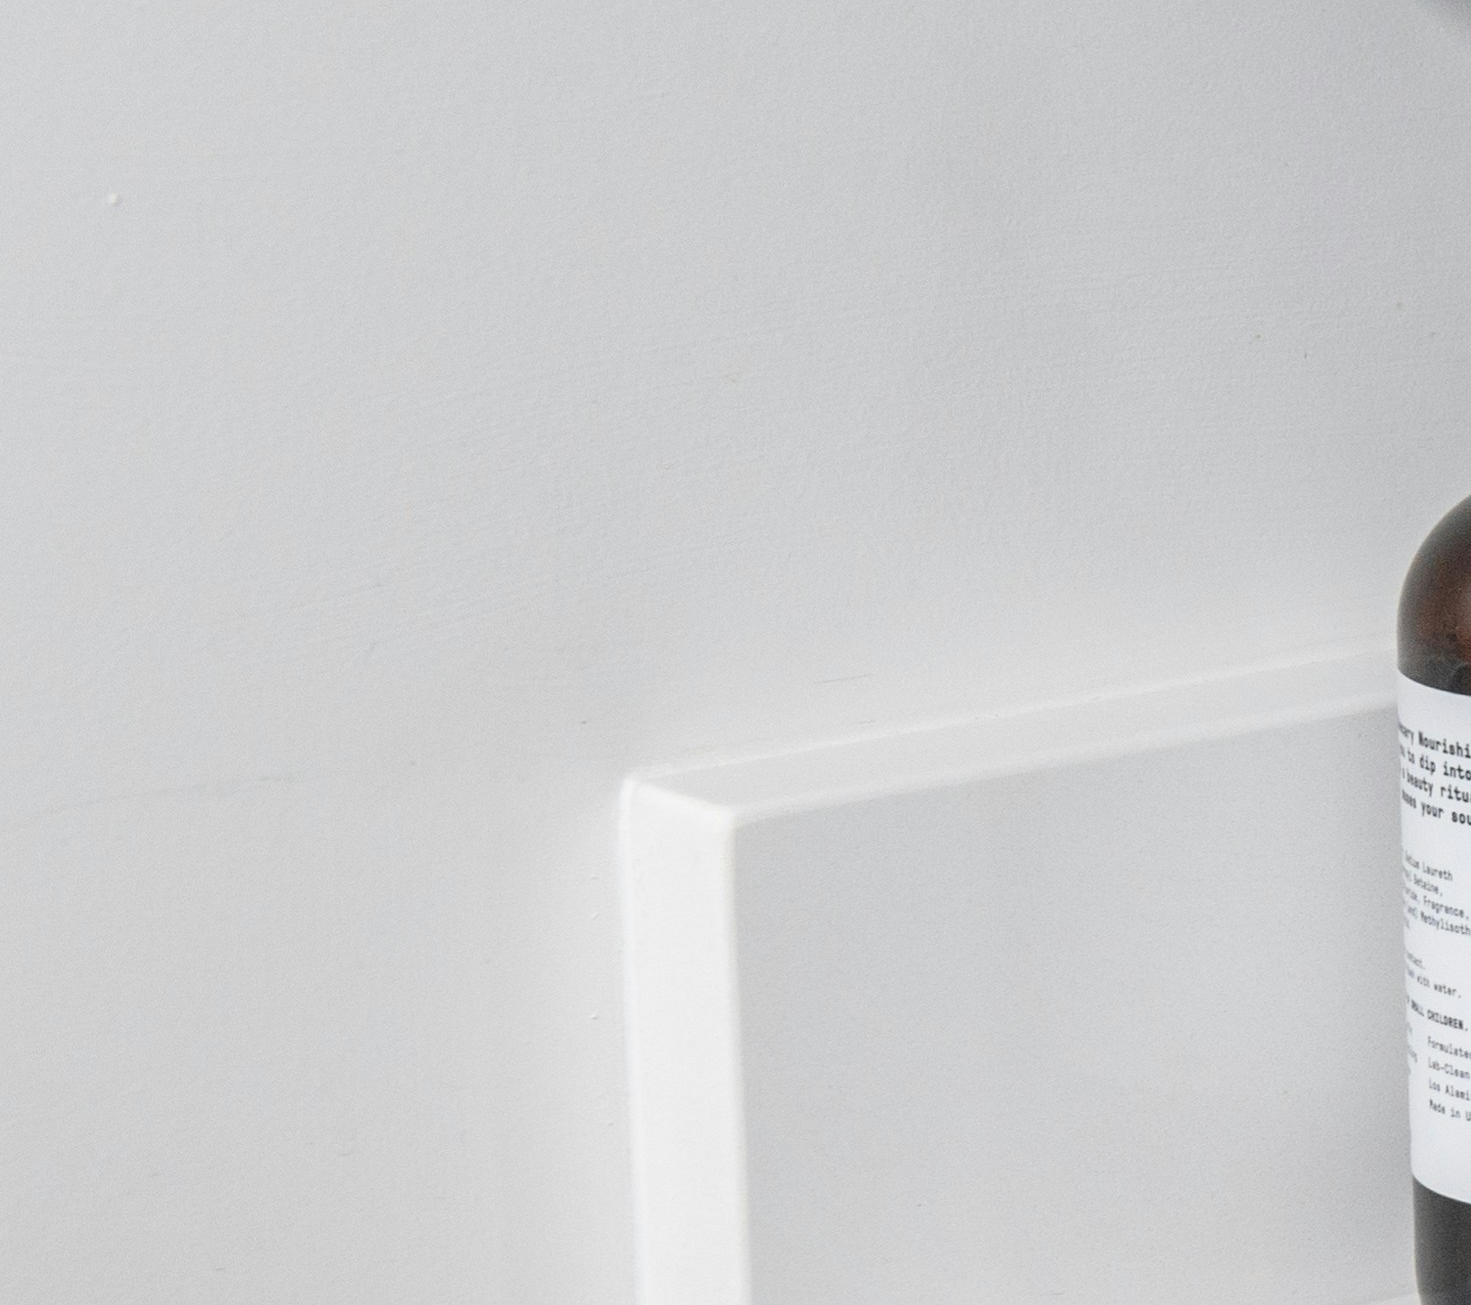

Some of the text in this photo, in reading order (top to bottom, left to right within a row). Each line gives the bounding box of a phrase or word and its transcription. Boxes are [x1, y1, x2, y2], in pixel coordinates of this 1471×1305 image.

[1419, 755, 1436, 773] dip
[1443, 762, 1471, 781] into
[1421, 801, 1444, 818] your
[1434, 983, 1462, 998] water.
[1427, 1009, 1468, 1032] CHILDREN.
[1427, 1057, 1470, 1080] Lab-Clean
[1429, 1078, 1441, 1092] Los
[1429, 1098, 1446, 1115] Made
[1450, 1103, 1461, 1118] in
